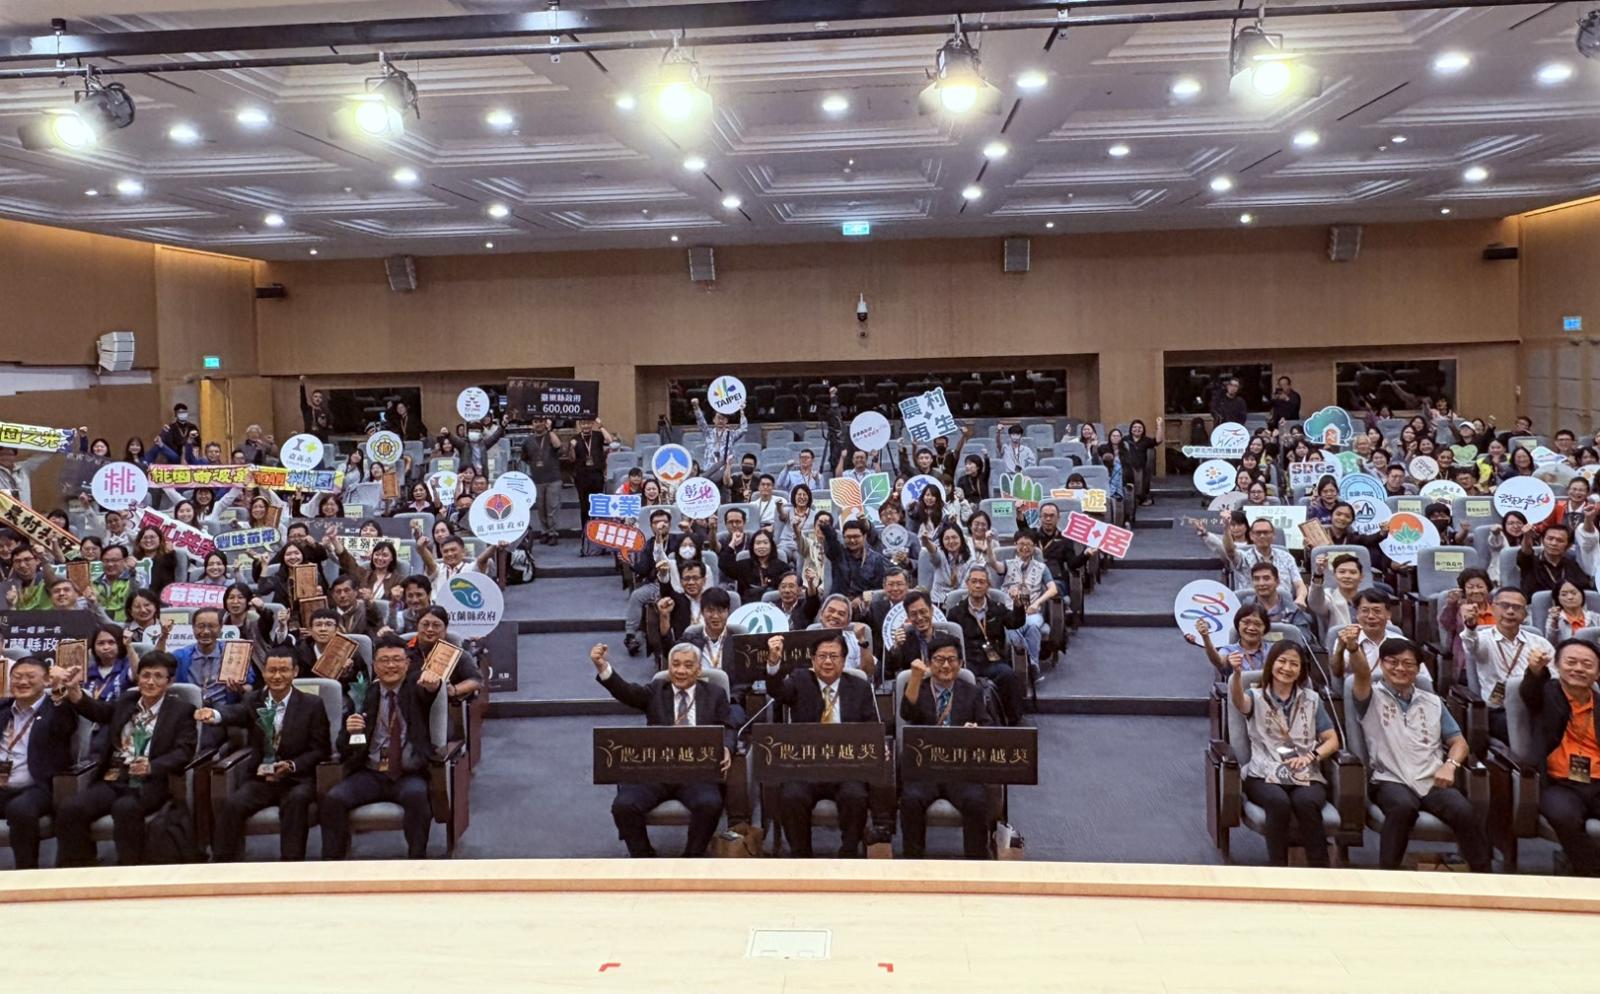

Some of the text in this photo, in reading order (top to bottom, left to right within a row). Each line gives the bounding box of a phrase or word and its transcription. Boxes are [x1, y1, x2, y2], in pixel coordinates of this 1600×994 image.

[715, 392, 742, 408] TAIPEI
[901, 389, 945, 419] 農村
[543, 403, 580, 414] 600,000
[909, 414, 956, 441] 再生
[1292, 463, 1335, 474] SDGs
